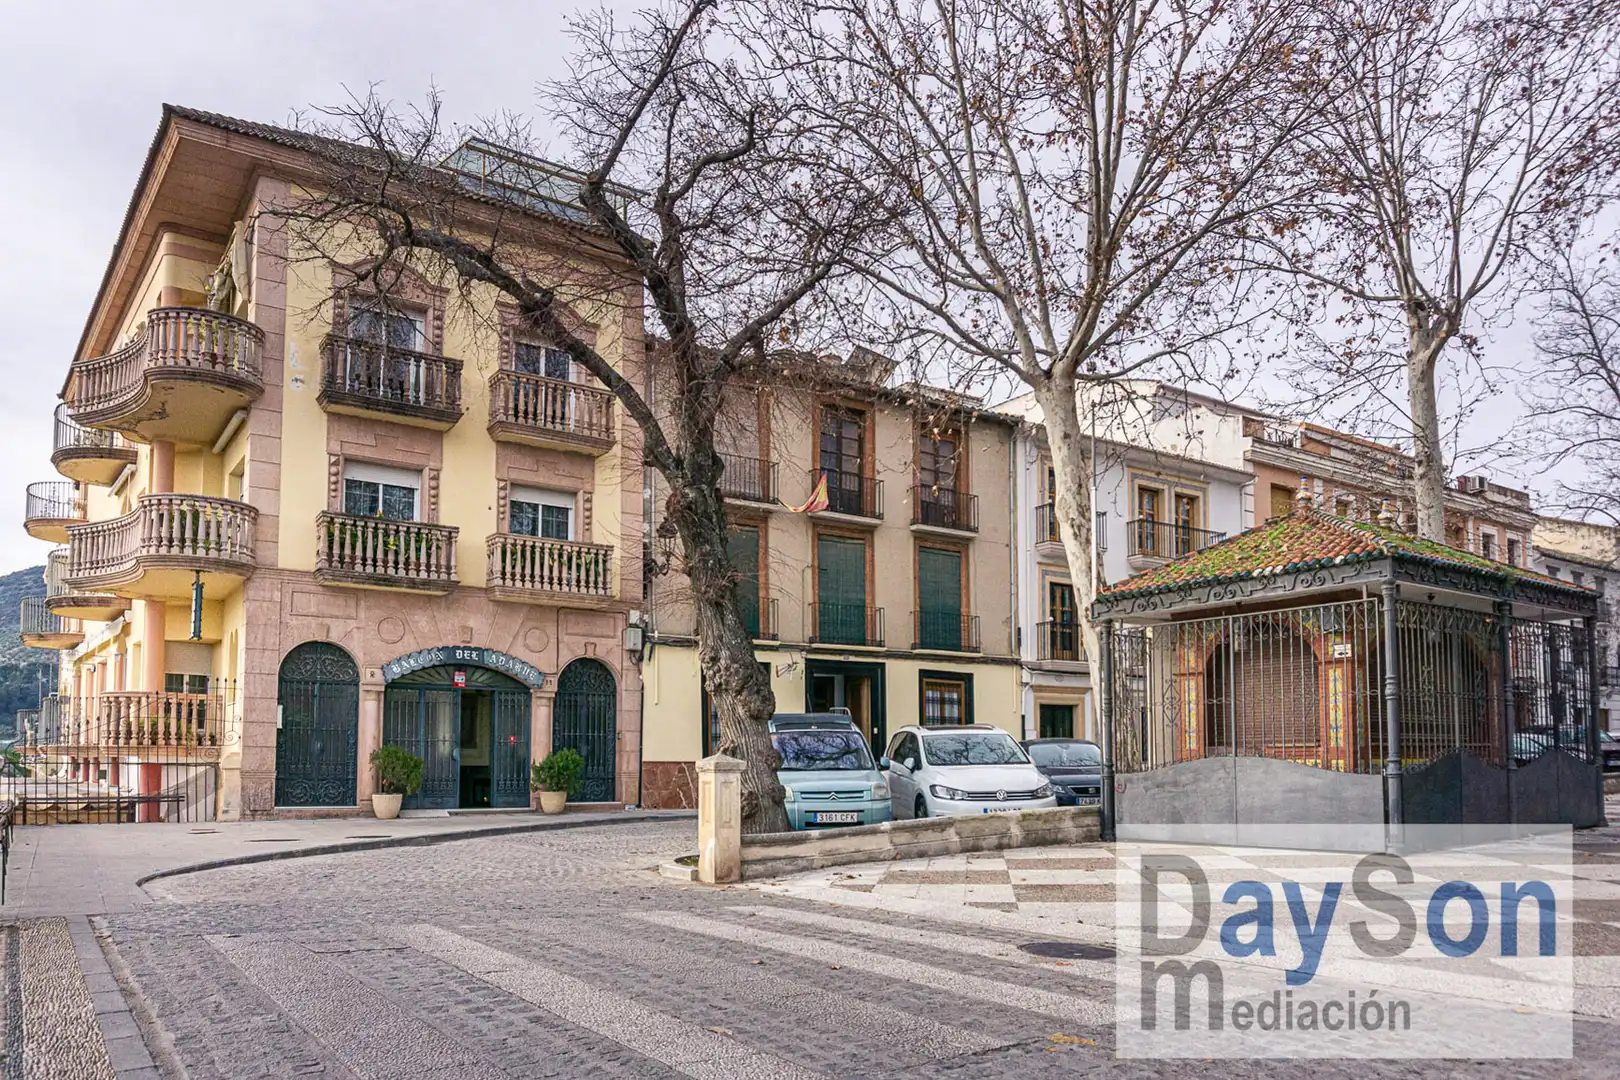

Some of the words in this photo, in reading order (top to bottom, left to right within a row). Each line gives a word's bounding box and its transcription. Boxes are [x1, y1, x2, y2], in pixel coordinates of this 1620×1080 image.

[455, 650, 479, 660] DEL
[819, 813, 838, 822] 3161
[840, 813, 856, 822] CFK
